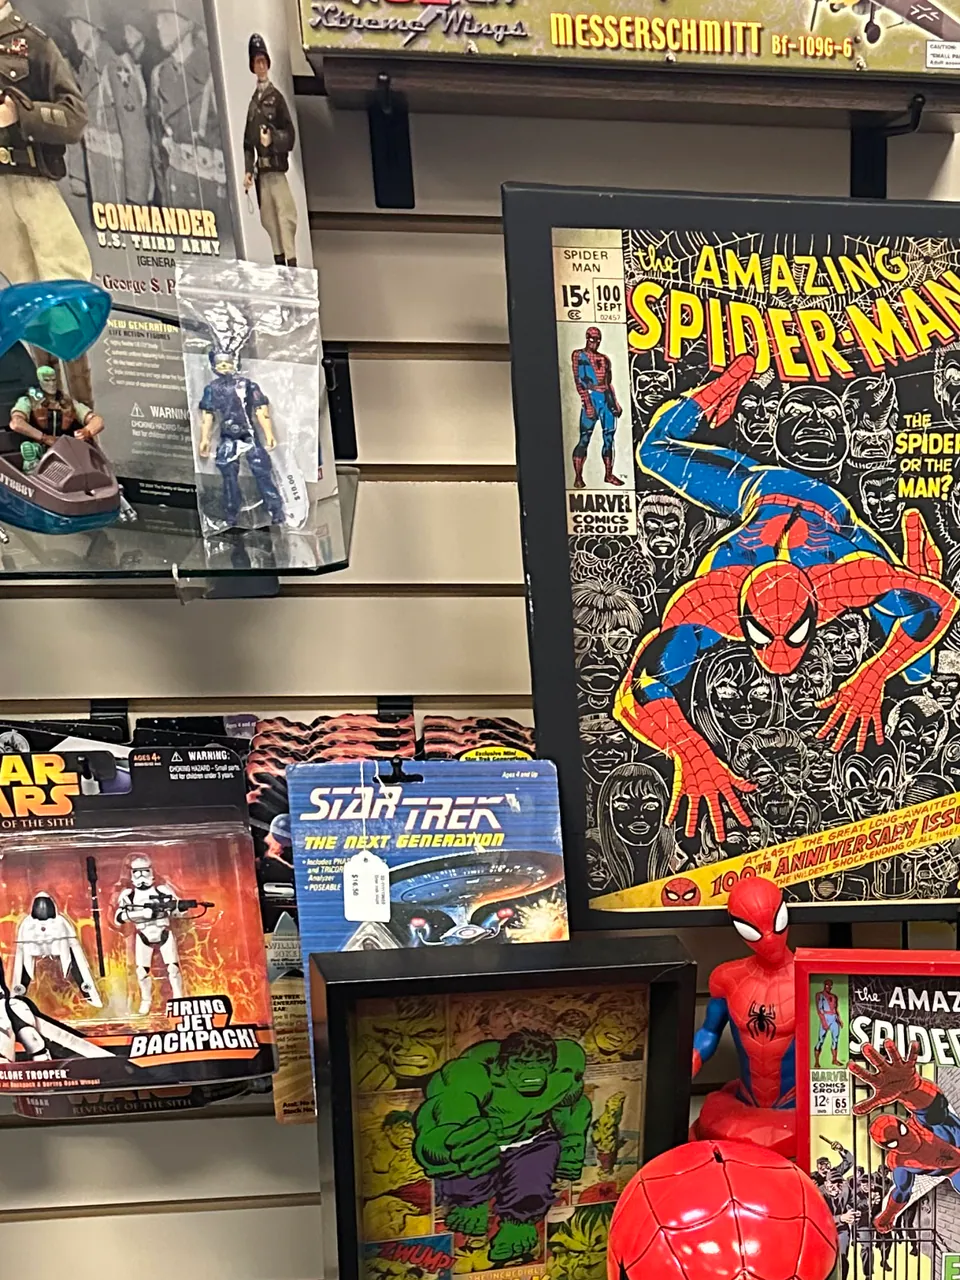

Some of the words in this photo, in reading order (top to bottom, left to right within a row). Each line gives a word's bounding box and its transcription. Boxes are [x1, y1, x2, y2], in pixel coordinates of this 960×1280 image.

[310, 4, 426, 32] Xtreme
[436, 8, 528, 42] Wings
[550, 12, 762, 54] MESSERSCHMITT
[771, 34, 853, 57] Bf-109G-6
[92, 202, 218, 238] COMMANDER
[97, 232, 126, 248] U.S.
[132, 235, 176, 252] THIRD
[182, 239, 220, 255] ARMY
[564, 250, 609, 261] SPIDER
[572, 263, 601, 273] MAN
[633, 248, 679, 274] the
[694, 244, 909, 296] AMAZING
[562, 285, 590, 307] 15¢
[596, 285, 621, 302] 100
[597, 303, 622, 312] SEPT
[107, 319, 126, 328] NEW
[129, 320, 179, 333] GENERATION
[904, 414, 931, 428] THE
[900, 459, 921, 472] OR
[925, 458, 952, 472] THE
[898, 474, 952, 500] MAN?
[569, 493, 632, 513] MARVEL
[572, 514, 629, 524] COMICS
[573, 524, 629, 534] GROUP
[188, 750, 230, 761] WARNING:
[300, 787, 402, 821] STAR
[402, 796, 504, 830] TREK
[2, 820, 17, 828] OF
[20, 819, 44, 827] THE
[47, 818, 74, 826] SITH
[743, 854, 760, 867] AT
[763, 842, 797, 862] LAST!
[803, 836, 823, 848] THE
[869, 796, 957, 829] LONG-AWAITED
[304, 836, 336, 850] THE
[344, 834, 388, 849] NEXT
[396, 832, 505, 848] GENERATION
[774, 821, 917, 878] ANNIVERSARY
[776, 874, 791, 885] THE
[794, 863, 830, 880] WILDEST
[832, 842, 905, 870] SHOCK-ENDING
[906, 839, 917, 850] OF
[918, 835, 933, 845] ALL
[935, 827, 958, 840] TIME!
[855, 987, 880, 1002] the
[165, 999, 227, 1017] FIRING
[177, 1015, 213, 1032] JET
[130, 1028, 259, 1056] BACKPACK!
[25, 1069, 67, 1080] TROOPER
[812, 1071, 848, 1082] MARVEL
[72, 1103, 121, 1114] REVENGE
[126, 1101, 141, 1110] OF
[143, 1101, 163, 1109] THE
[167, 1100, 192, 1108] SITH
[835, 1098, 847, 1108] 65
[488, 1267, 546, 1280] INCREDIBLE
